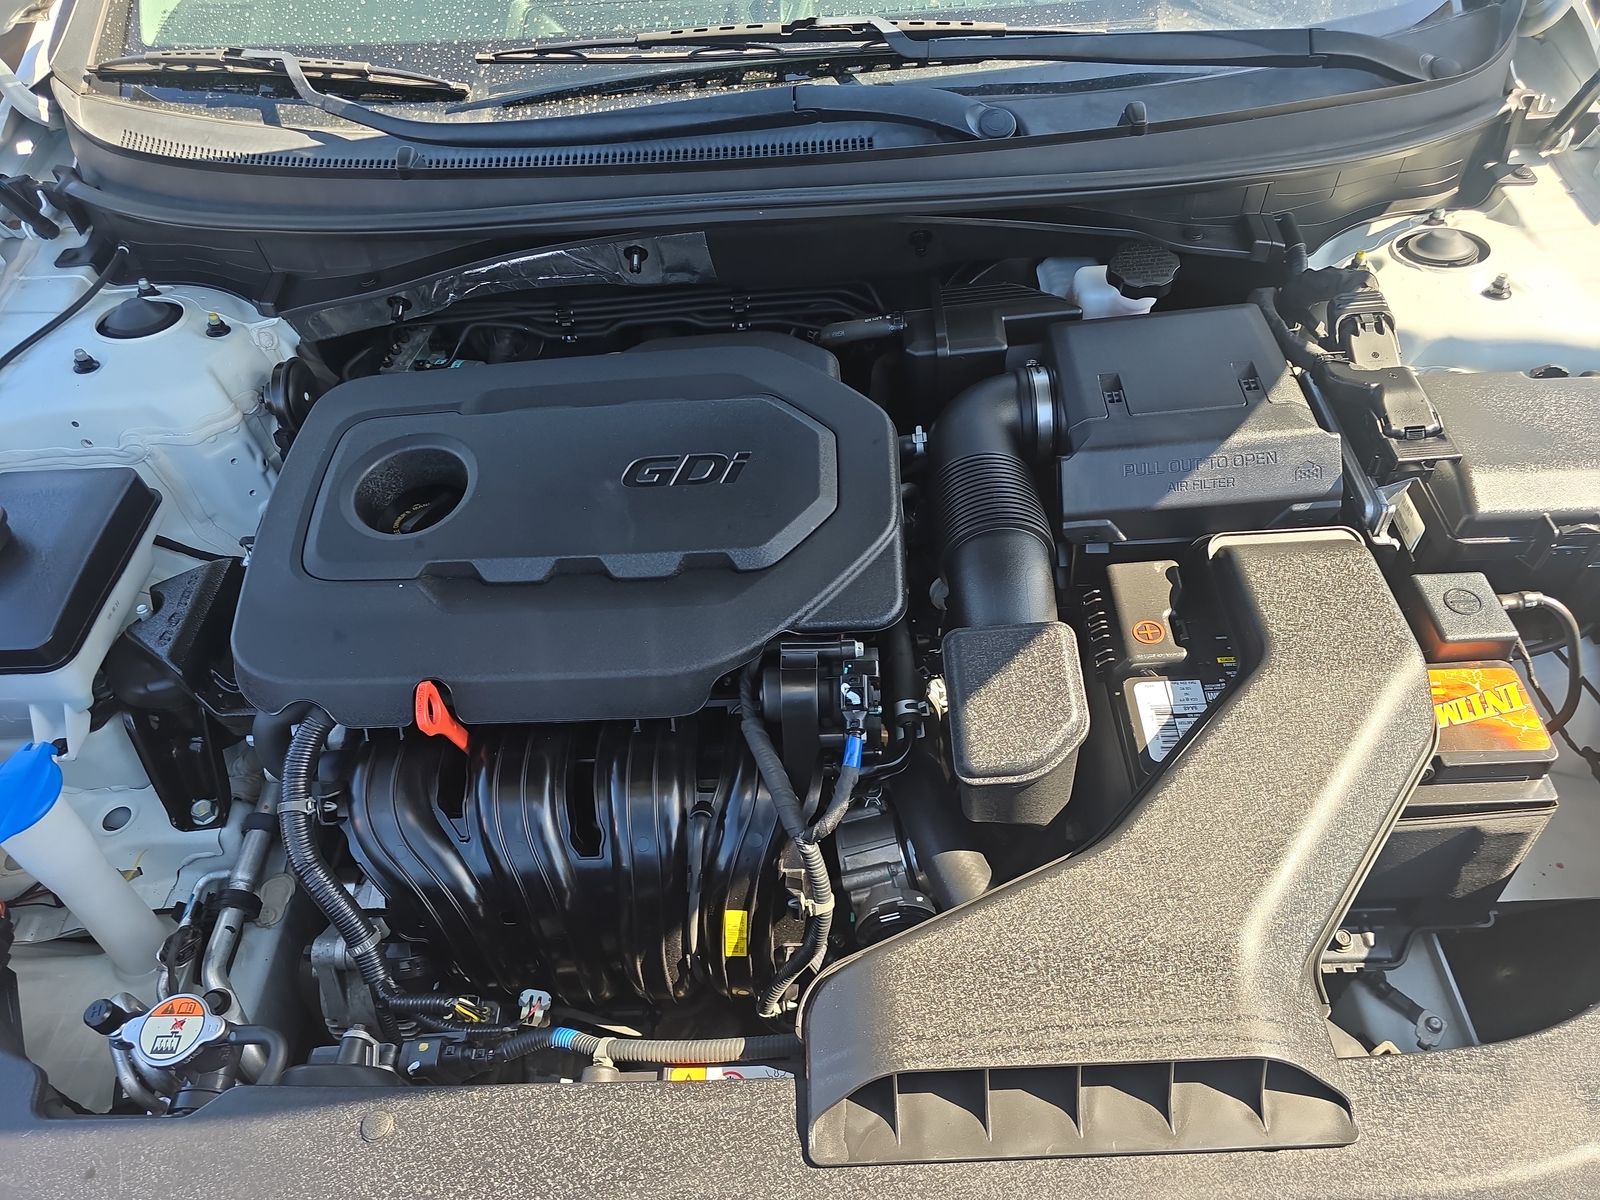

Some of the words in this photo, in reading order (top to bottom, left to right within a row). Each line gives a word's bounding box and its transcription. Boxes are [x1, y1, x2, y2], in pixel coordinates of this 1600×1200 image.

[620, 450, 753, 488] GDi
[1122, 462, 1165, 478] PULL
[1168, 458, 1203, 474] OUT
[1208, 455, 1229, 471] TO
[1232, 450, 1278, 468] OPEN
[1167, 480, 1189, 493] AIR
[1192, 476, 1236, 491] FILTER
